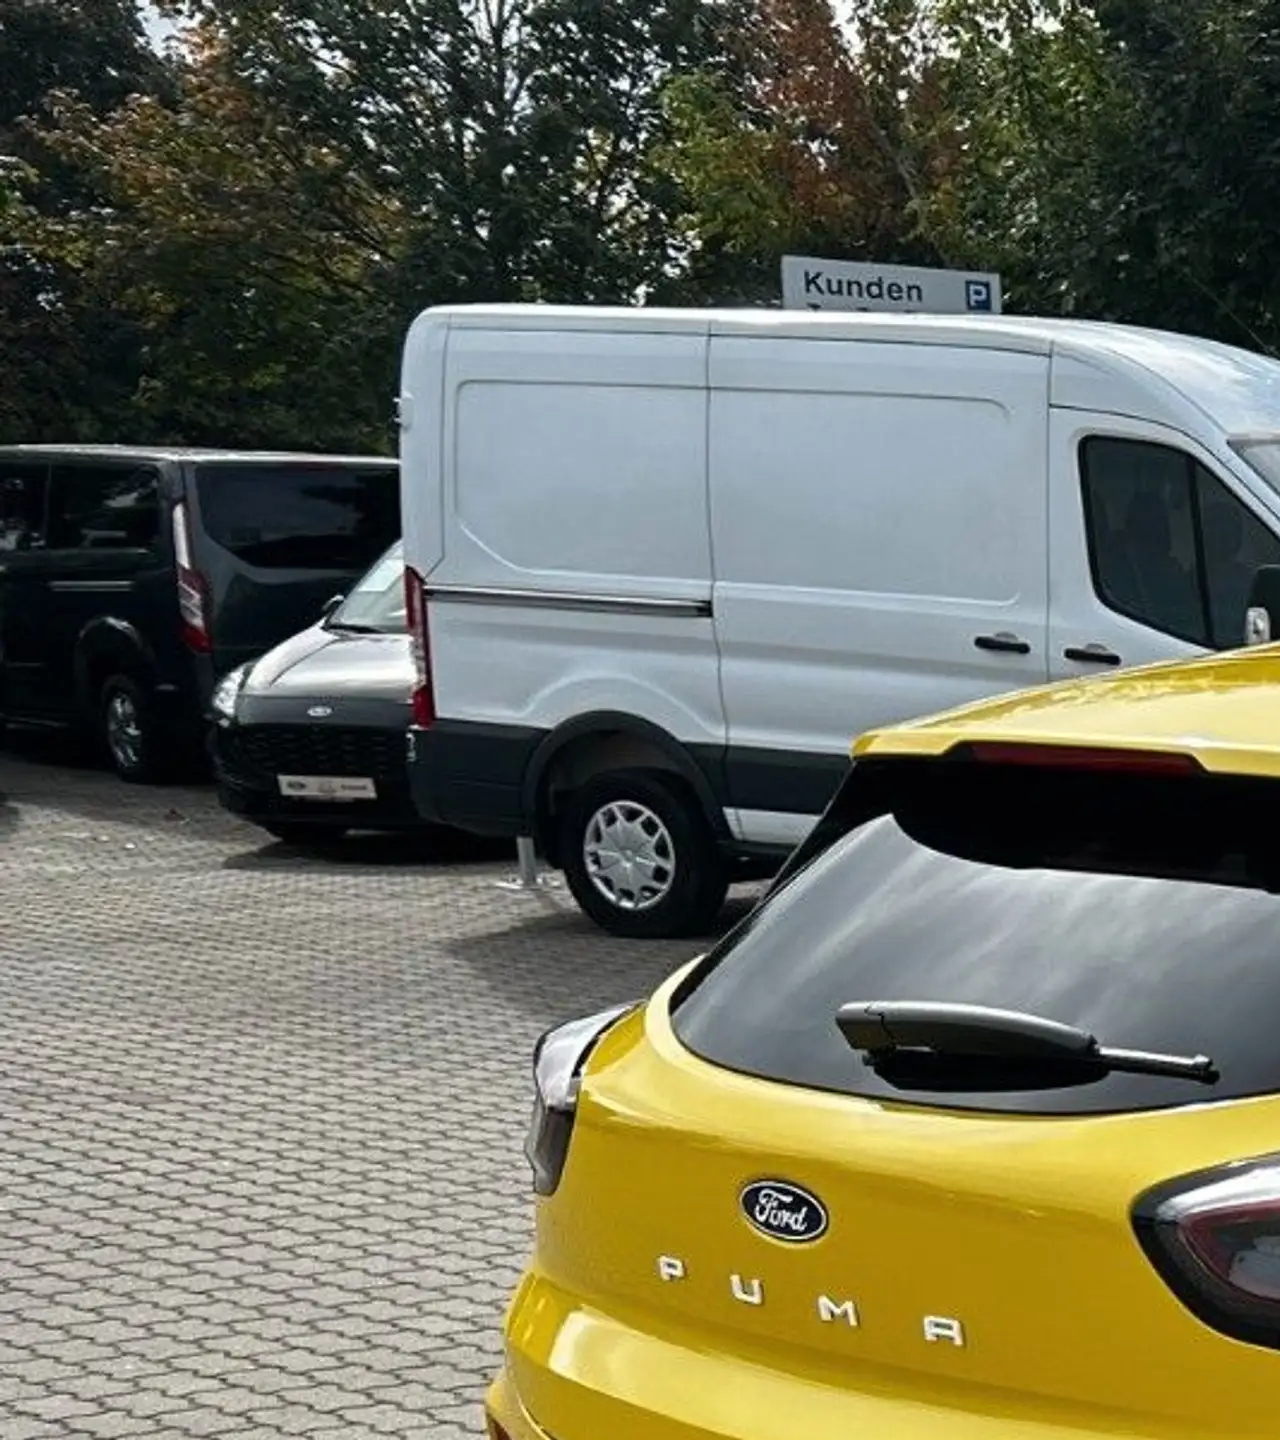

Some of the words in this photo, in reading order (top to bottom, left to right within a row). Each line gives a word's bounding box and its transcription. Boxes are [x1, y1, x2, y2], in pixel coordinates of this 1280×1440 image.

[804, 271, 923, 301] Kunden
[755, 1188, 807, 1231] Ford
[657, 1255, 964, 1346] PUMA
